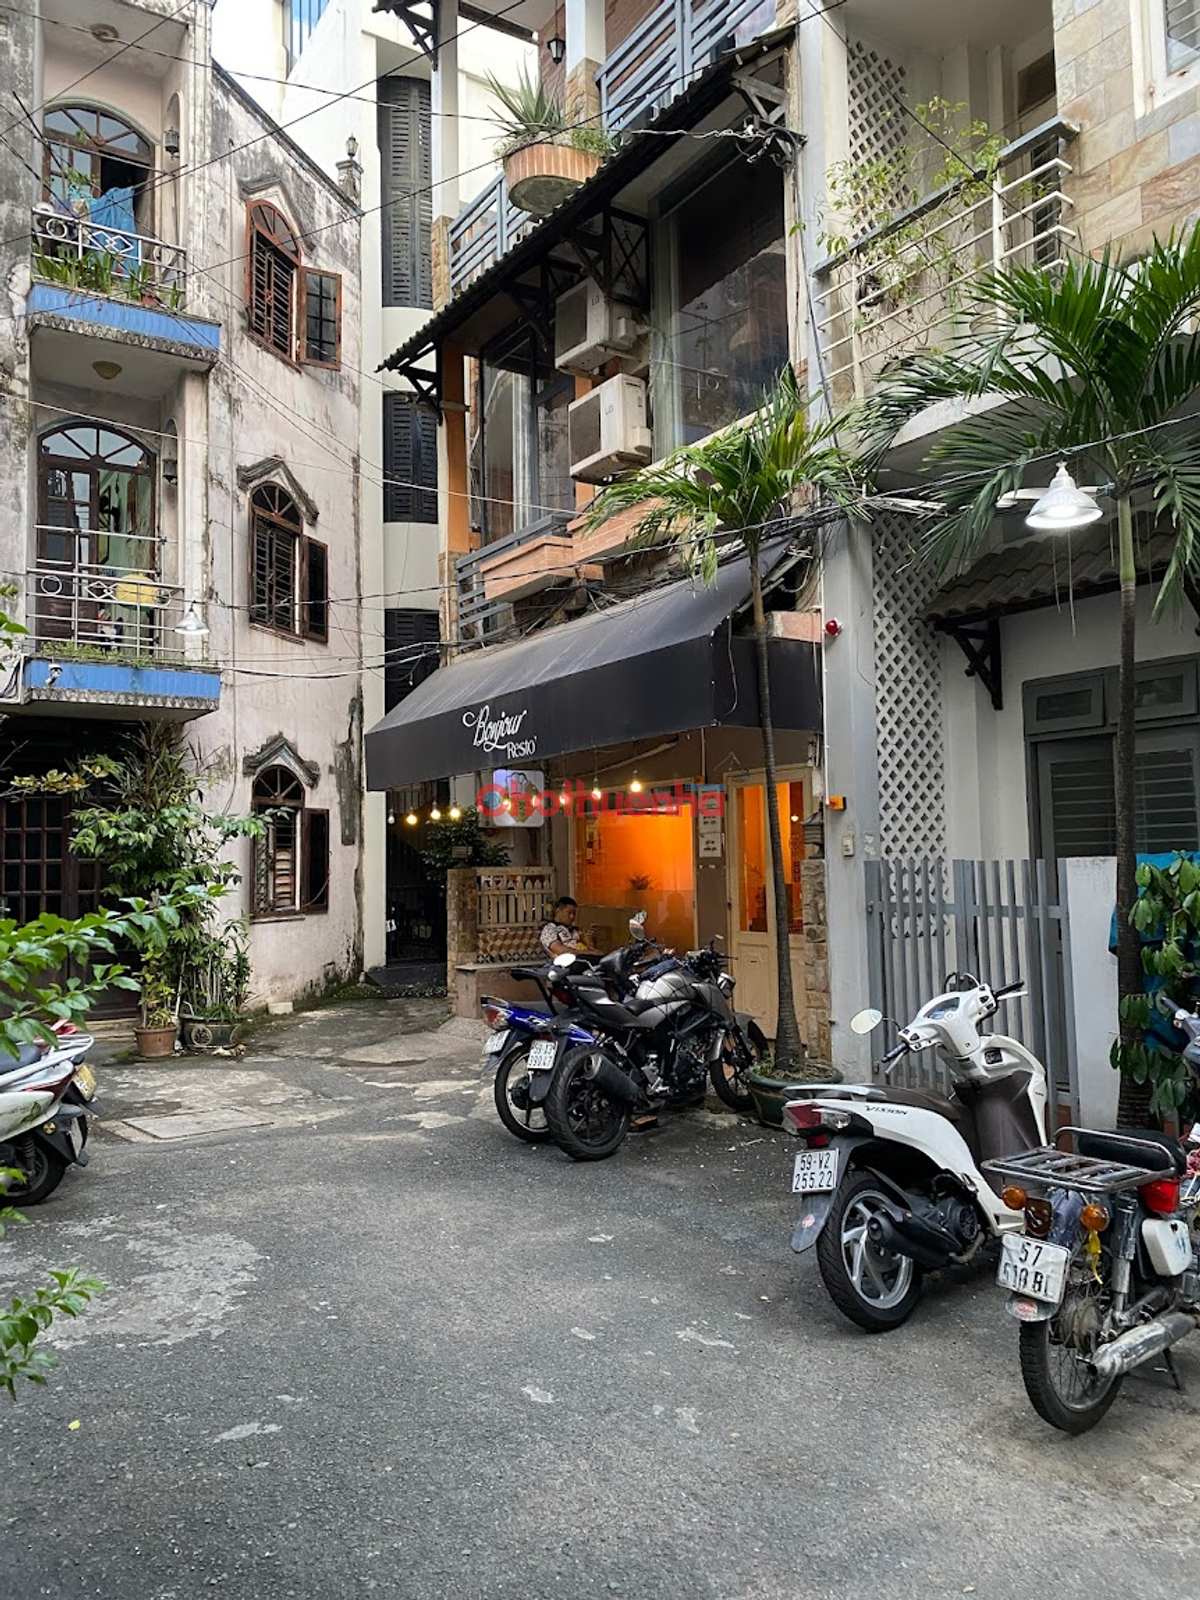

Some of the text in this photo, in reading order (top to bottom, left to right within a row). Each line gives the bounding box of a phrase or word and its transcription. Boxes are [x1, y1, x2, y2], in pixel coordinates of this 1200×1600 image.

[591, 296, 600, 306] LG
[462, 704, 527, 752] Bonjour
[794, 1170, 833, 1190] 255.22
[1018, 1241, 1043, 1266] 57
